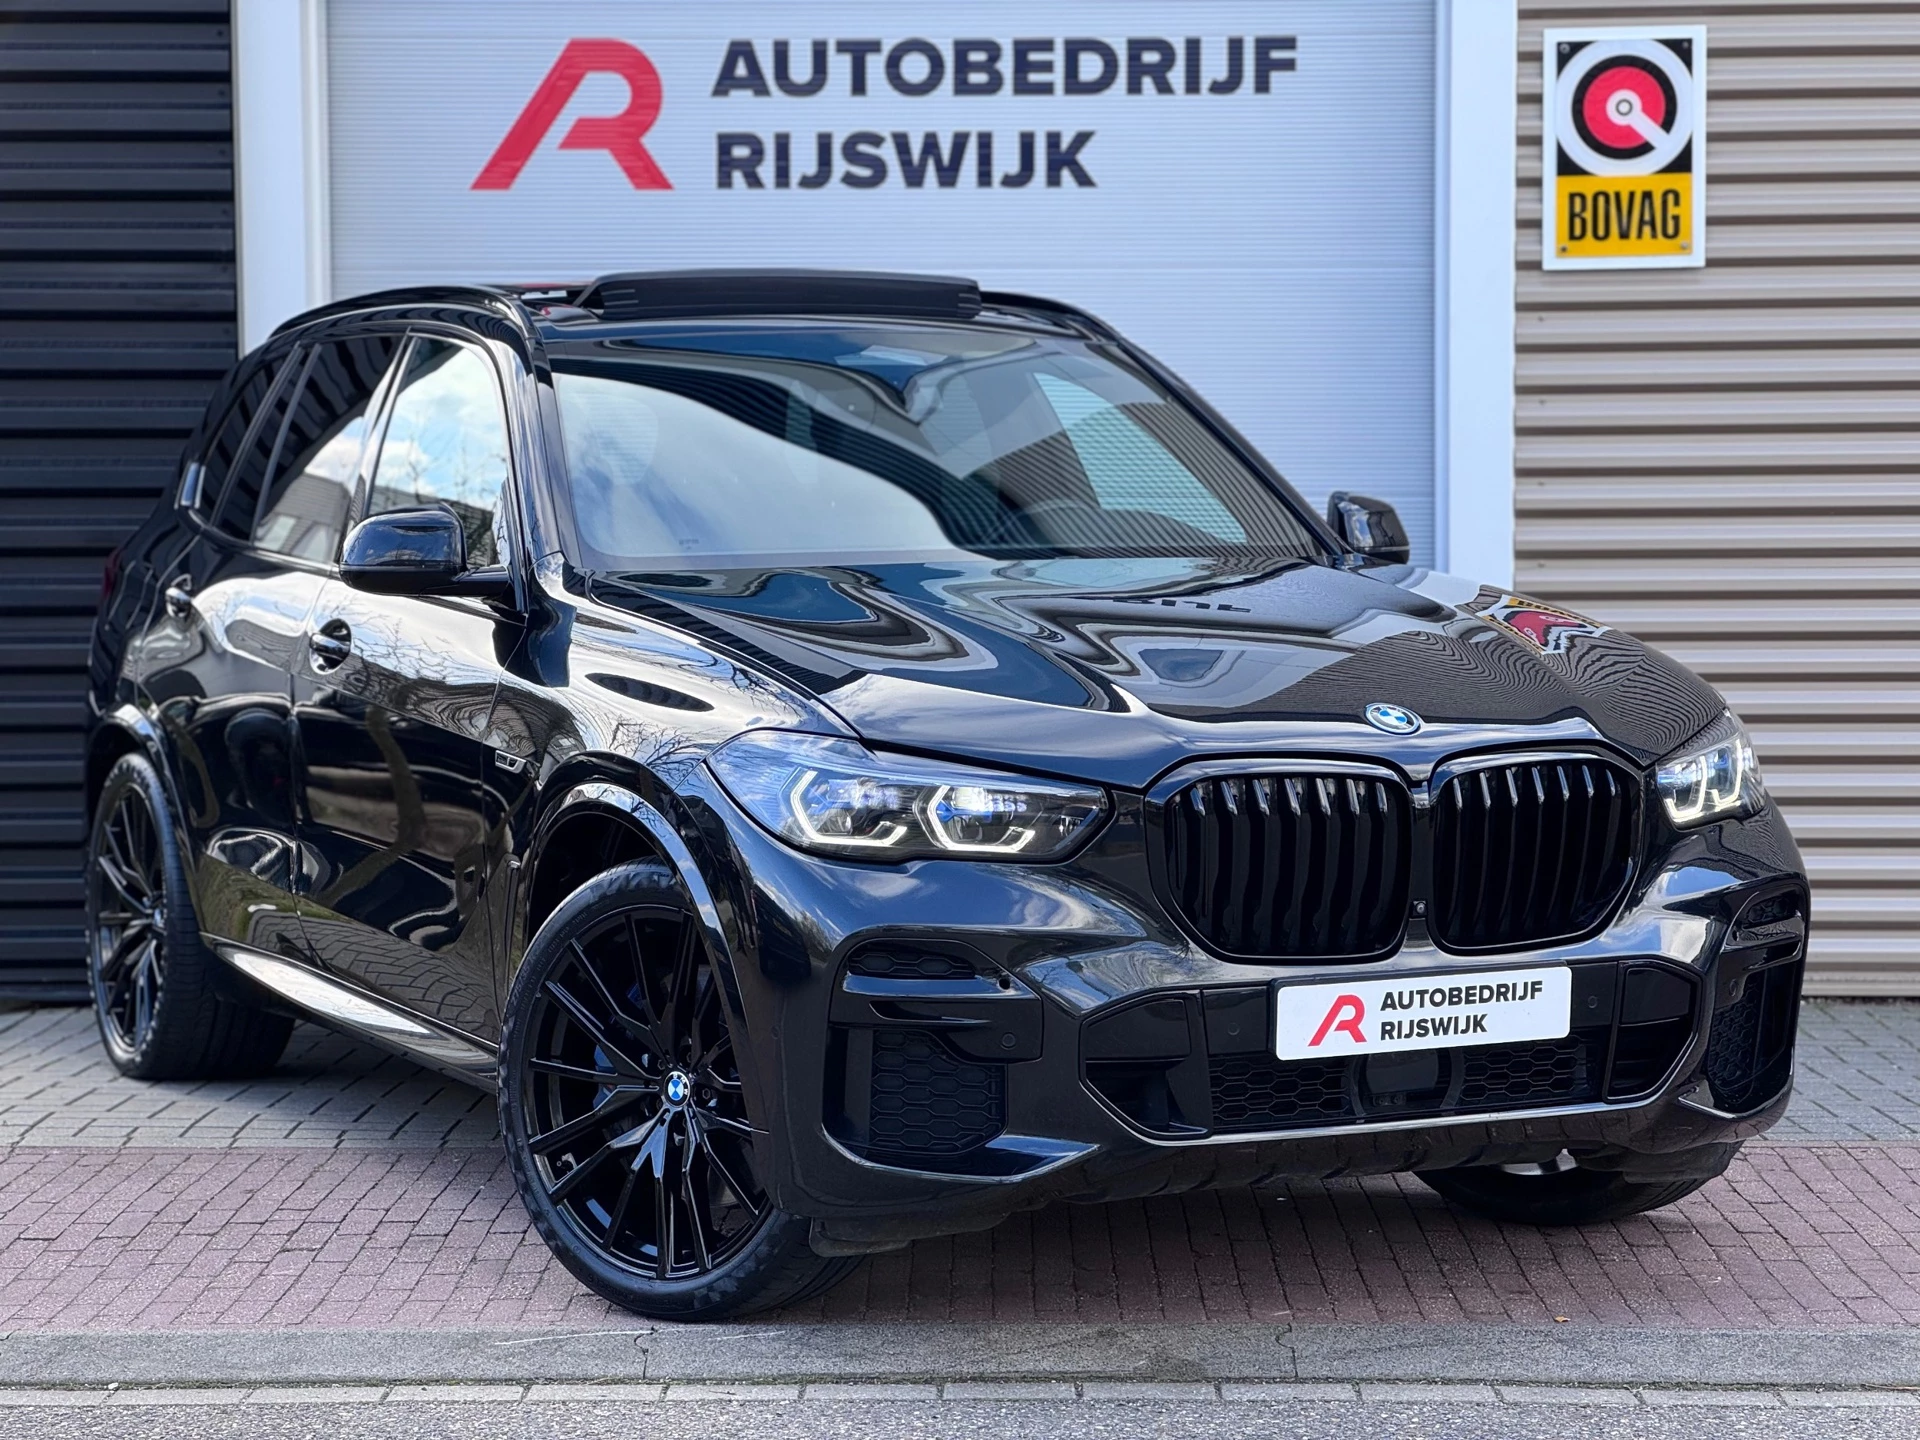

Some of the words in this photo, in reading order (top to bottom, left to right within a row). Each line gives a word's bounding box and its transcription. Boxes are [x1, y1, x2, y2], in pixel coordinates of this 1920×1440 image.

[711, 37, 1297, 97] AUTOBEDRIJF
[716, 131, 1097, 190] RIJSWIJK
[1568, 189, 1681, 241] BOVAG
[1380, 980, 1543, 1012] AUTOBEDRIJF
[1380, 1013, 1488, 1041] RIJSWIJK
